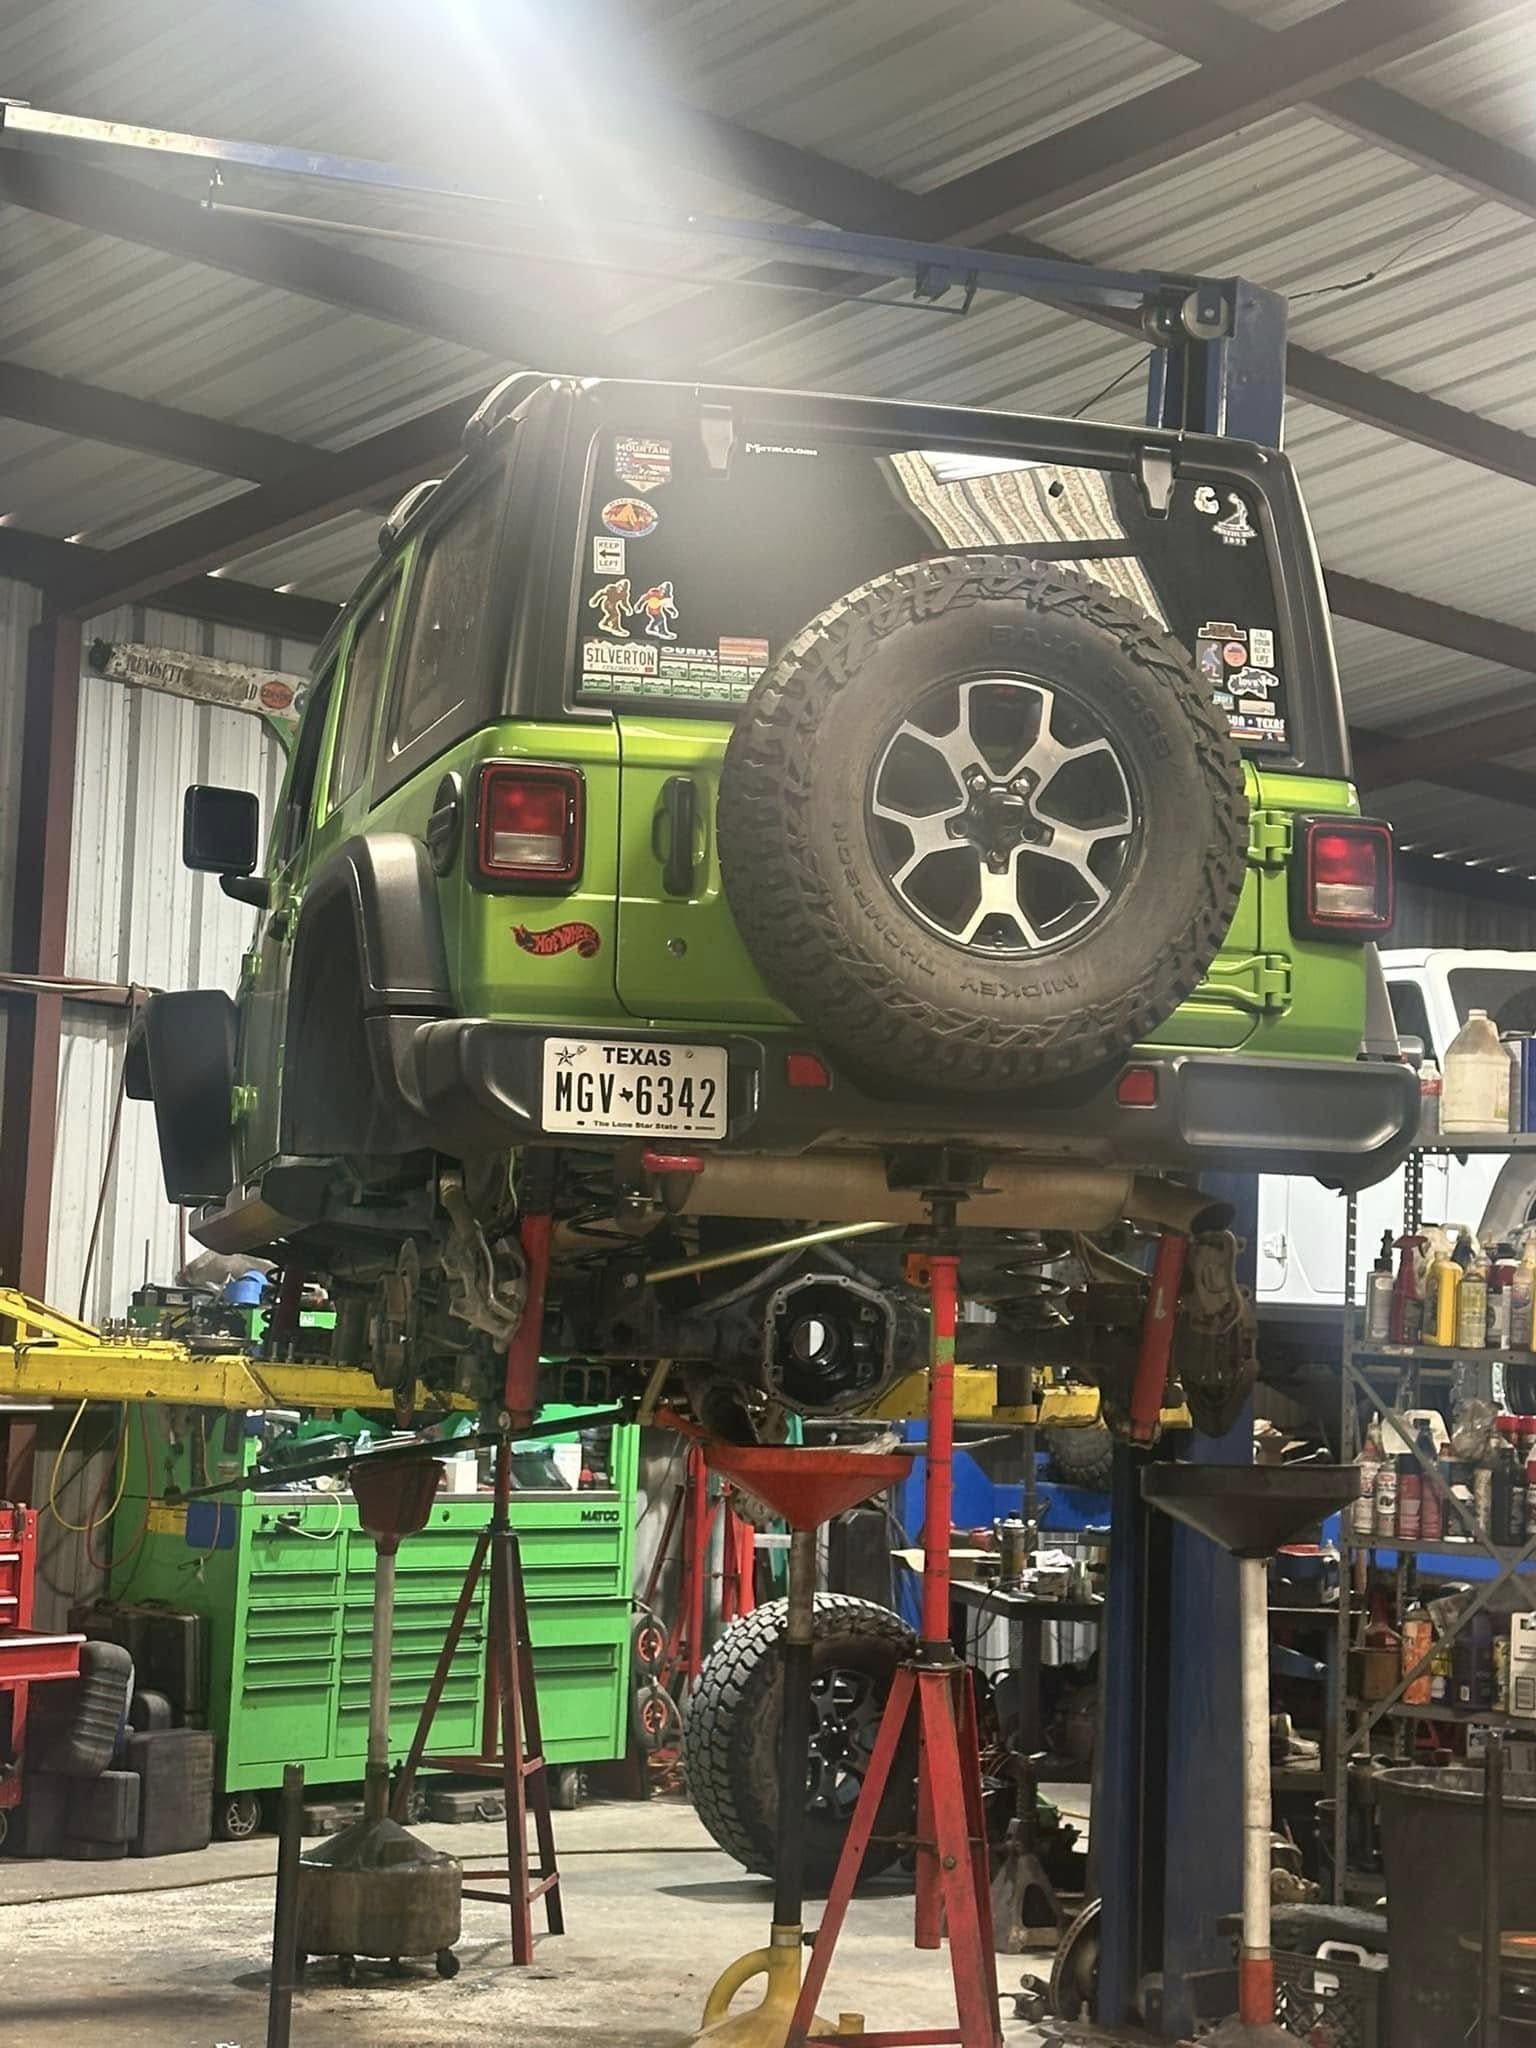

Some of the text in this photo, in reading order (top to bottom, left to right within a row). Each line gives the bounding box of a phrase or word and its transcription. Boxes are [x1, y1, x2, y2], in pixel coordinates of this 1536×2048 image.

[599, 541, 620, 549] KEEP
[599, 559, 618, 567] LEFT
[586, 647, 655, 666] SILVERTON
[603, 1047, 671, 1067] TEXAS
[581, 1510, 620, 1522] MATCO
